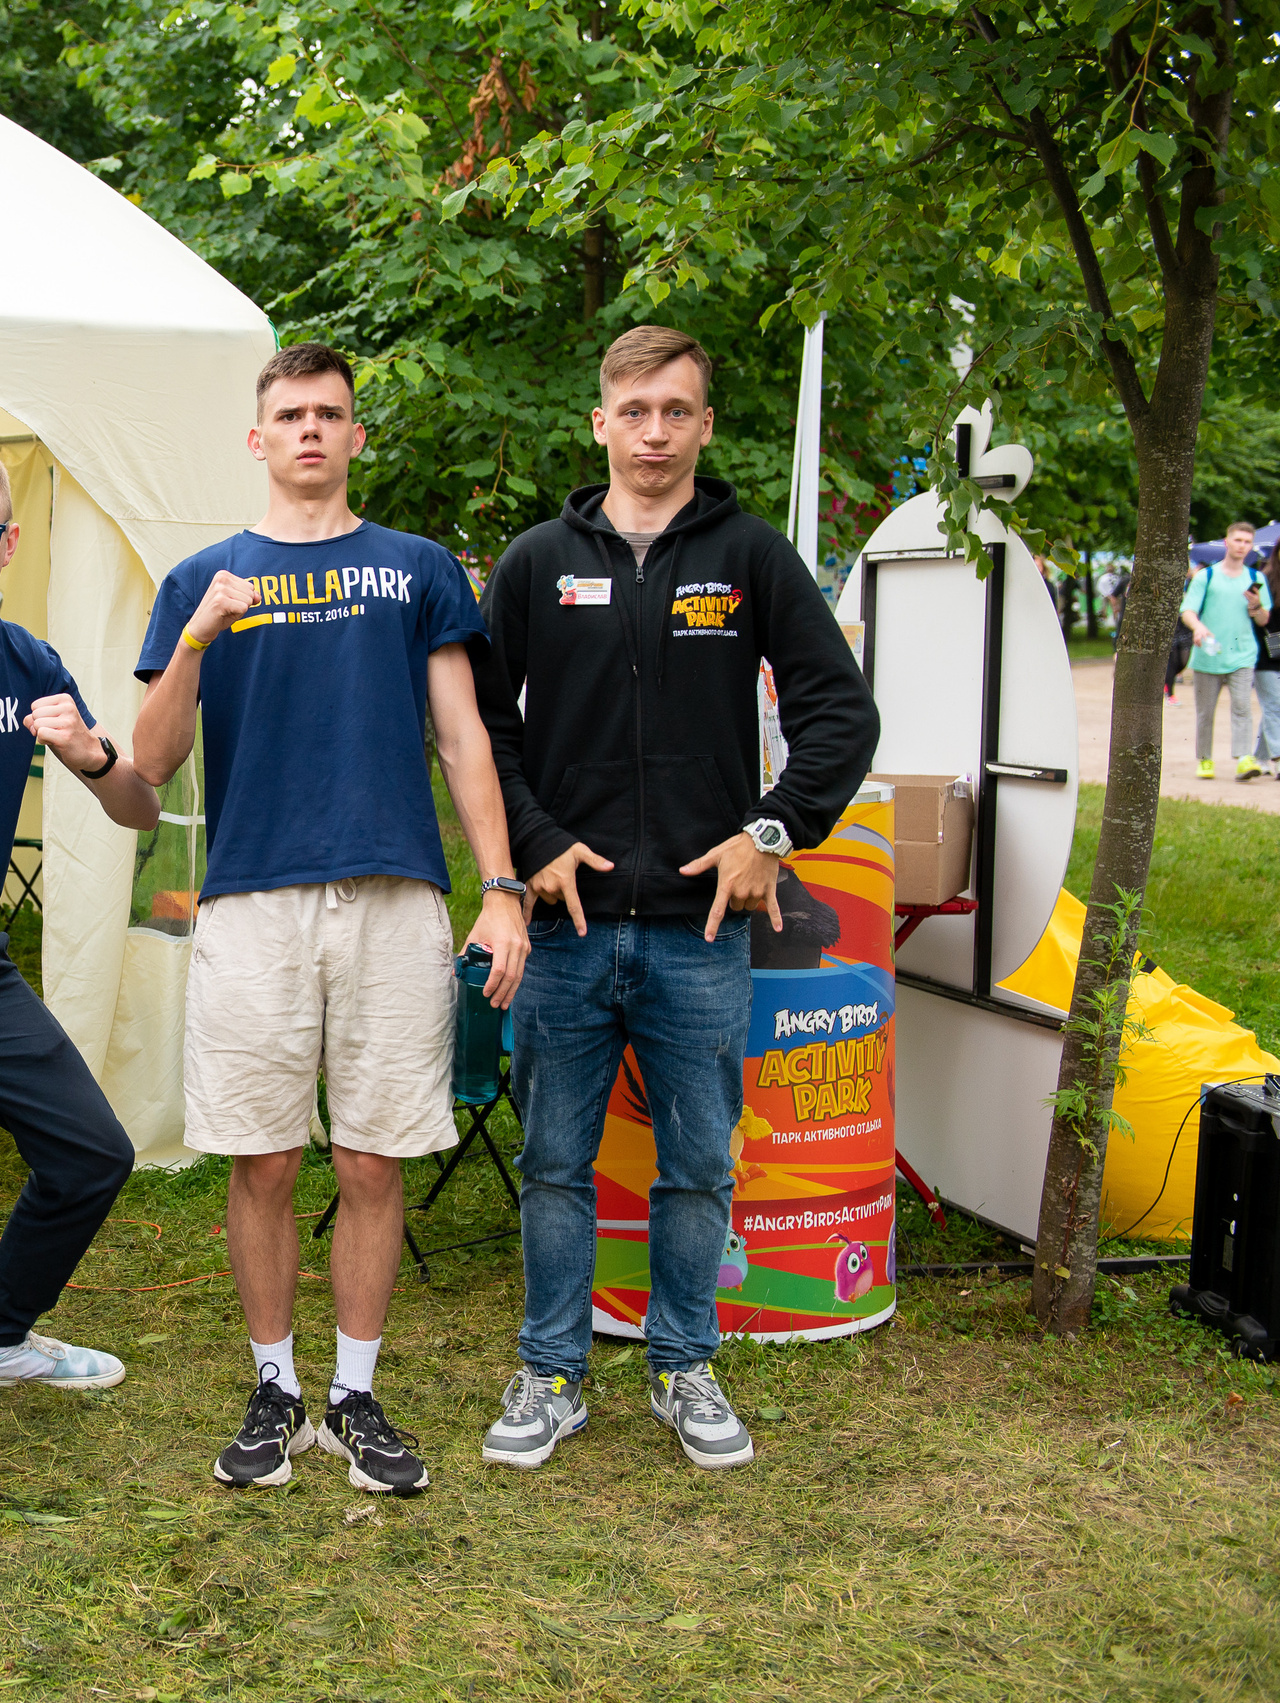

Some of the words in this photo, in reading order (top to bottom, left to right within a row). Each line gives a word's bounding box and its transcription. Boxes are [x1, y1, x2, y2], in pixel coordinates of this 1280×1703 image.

[245, 566, 413, 608] ORILLAPARK
[676, 583, 705, 598] ANGRY
[705, 581, 732, 594] BIRDS
[301, 611, 324, 623] EST.
[325, 606, 350, 622] 2016
[671, 595, 740, 614] ACTIVITY
[685, 611, 726, 628] PARK
[773, 1008, 837, 1041] ANGRY
[837, 1001, 879, 1034] BIRDS
[756, 1032, 887, 1088] ACTIVITY
[792, 1075, 873, 1123] PARK
[772, 1132, 802, 1144] ПАРК
[803, 1124, 856, 1143] АКТИВНОГО
[856, 1117, 882, 1134] ОТДЫХА
